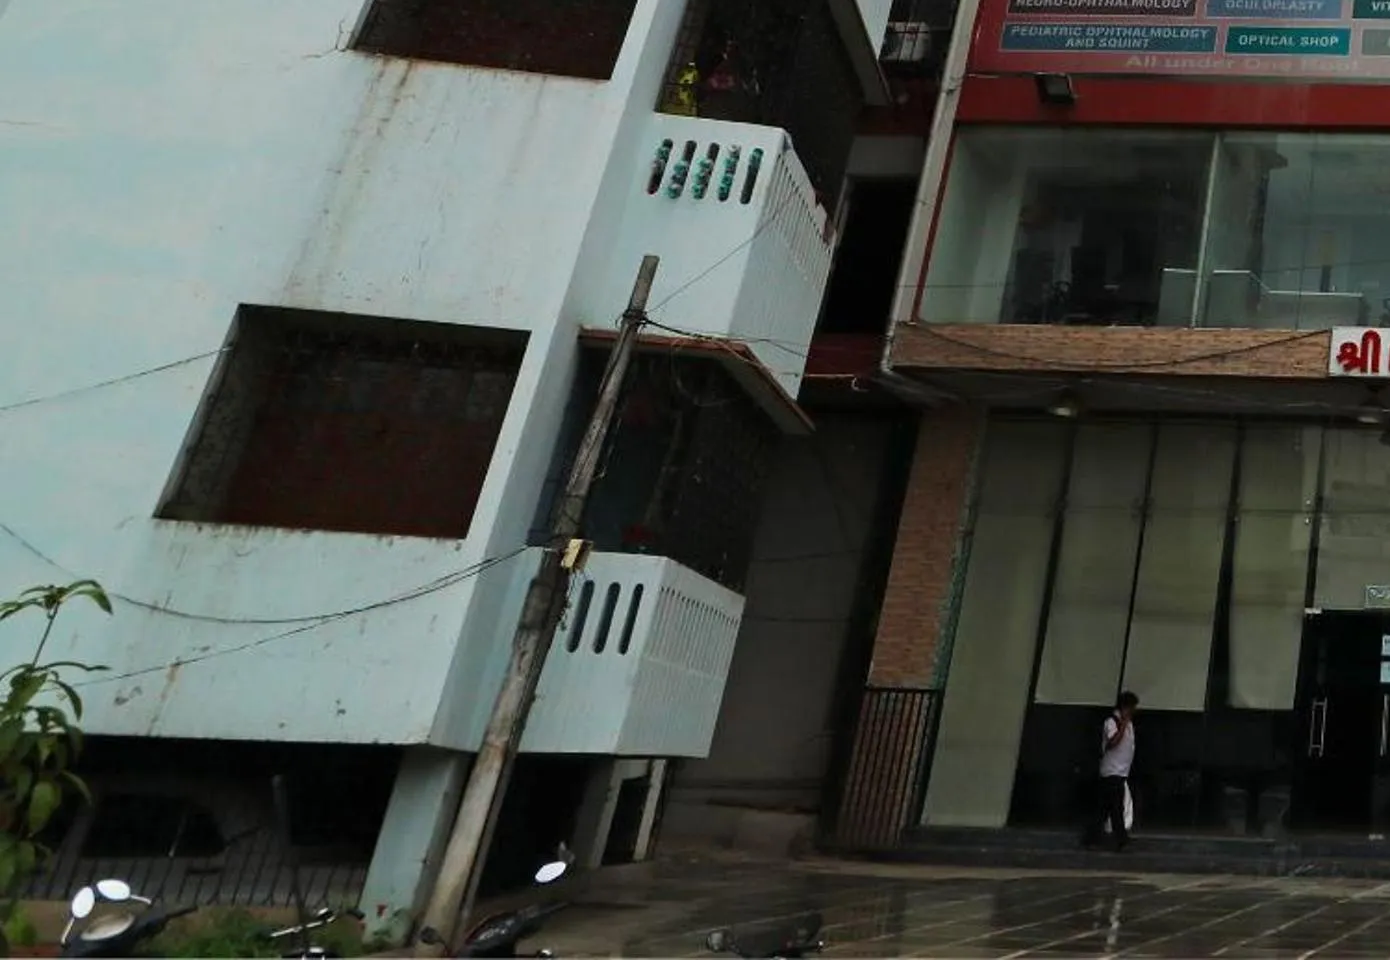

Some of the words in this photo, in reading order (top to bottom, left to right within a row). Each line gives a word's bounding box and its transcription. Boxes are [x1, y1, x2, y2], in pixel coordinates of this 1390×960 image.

[1011, 25, 1082, 37] PEDIATRIC
[1085, 26, 1210, 39] OPHTHALMOLOGY
[1065, 38, 1094, 48] AND
[1098, 38, 1152, 49] SQUINT
[1238, 34, 1295, 46] OPTICAL
[1300, 36, 1340, 48] SHOP
